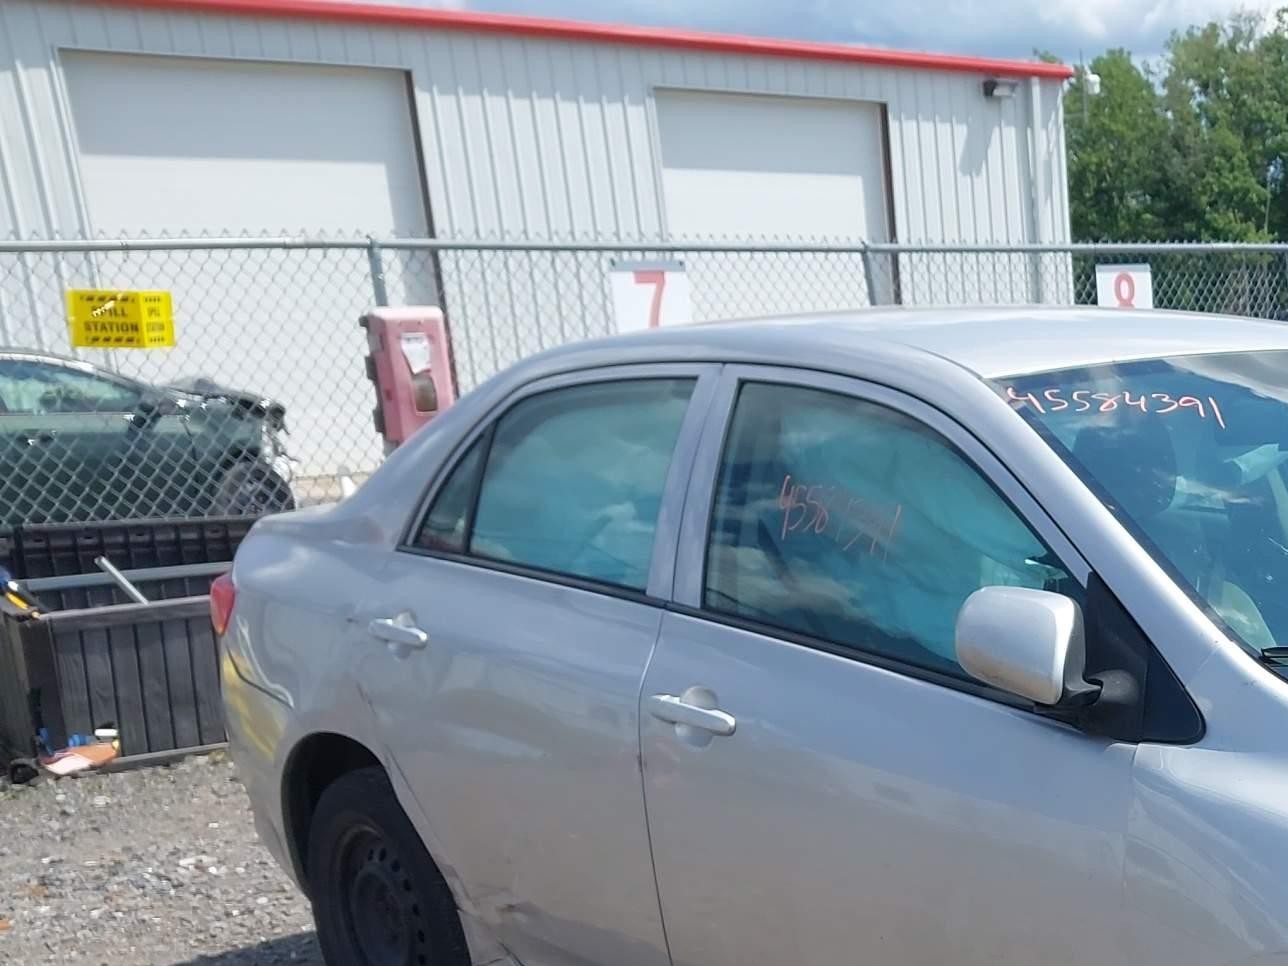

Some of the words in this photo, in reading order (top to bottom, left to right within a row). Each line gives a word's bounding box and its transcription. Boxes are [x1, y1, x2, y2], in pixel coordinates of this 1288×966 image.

[632, 269, 665, 329] 7
[84, 321, 139, 332] STATION
[1007, 387, 1226, 430] 45584391
[778, 474, 901, 569] 45581
